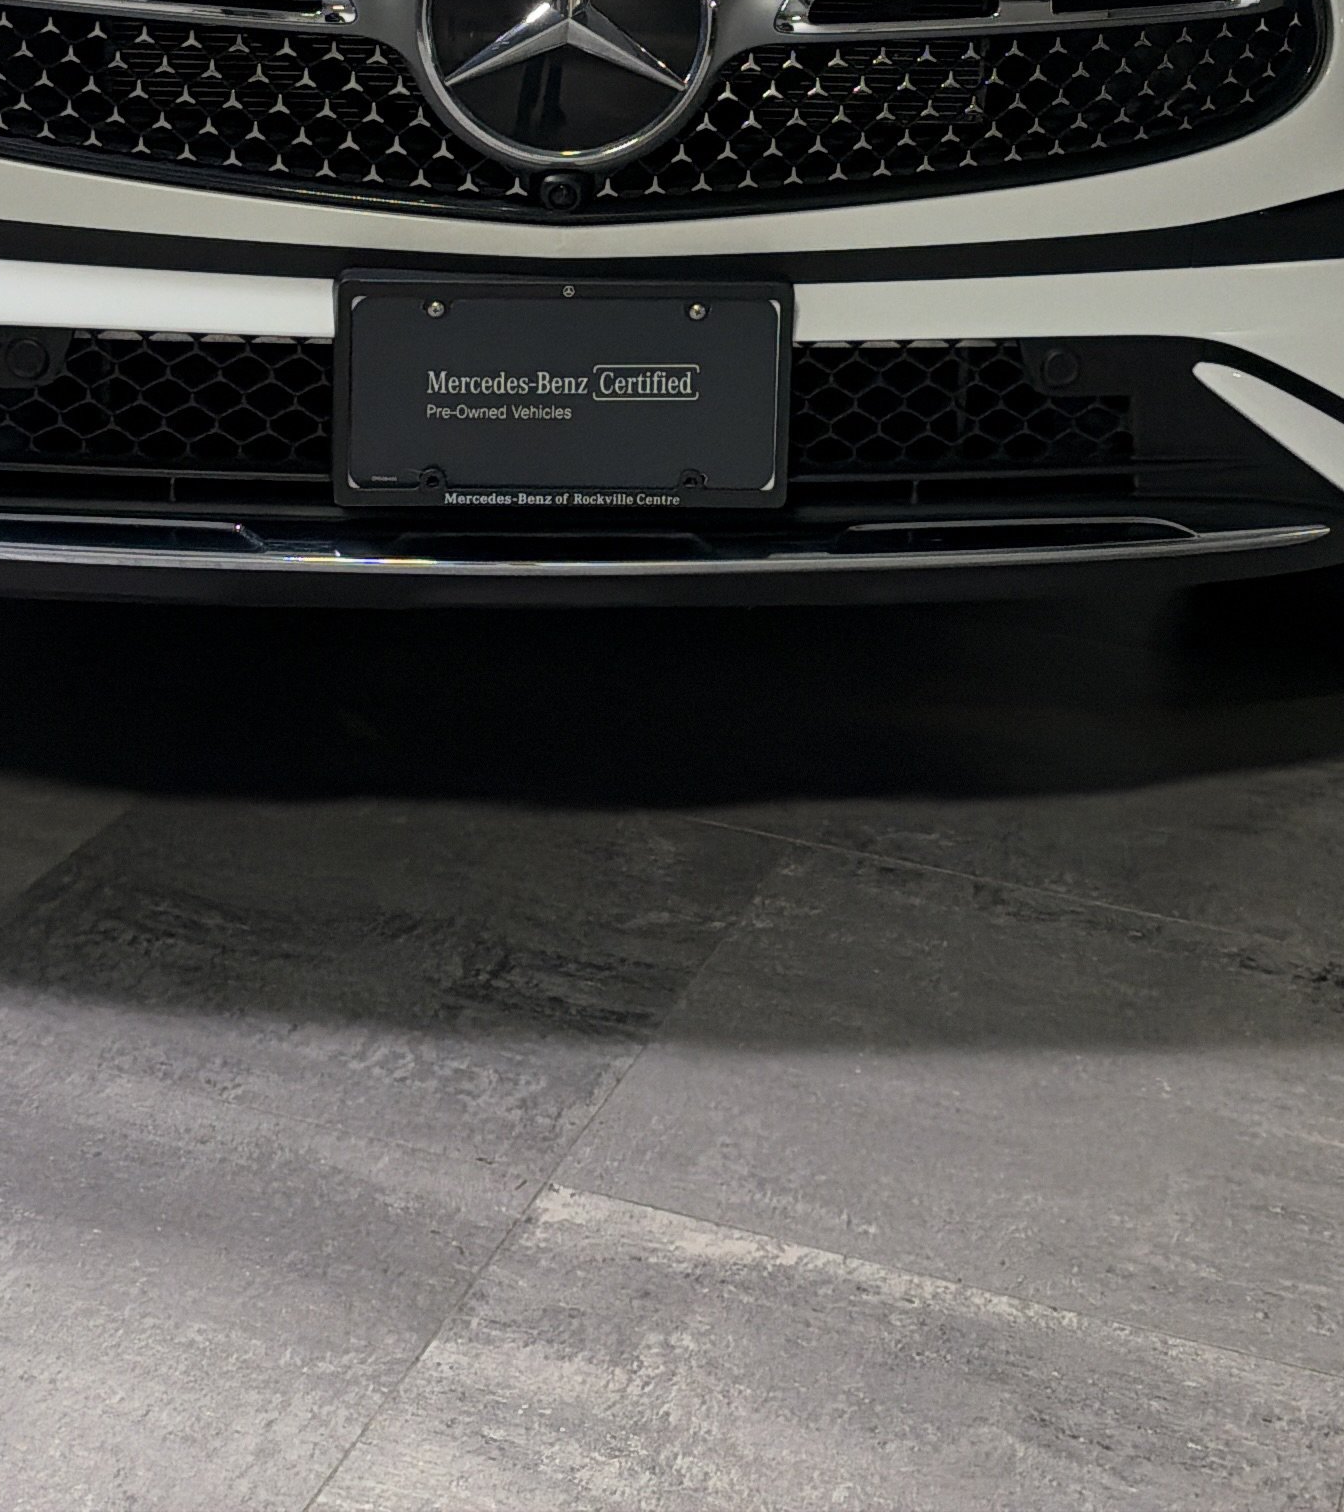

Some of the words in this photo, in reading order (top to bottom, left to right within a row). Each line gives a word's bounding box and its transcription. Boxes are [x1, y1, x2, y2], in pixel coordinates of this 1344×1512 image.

[426, 370, 589, 396] Mercedes-Benz
[599, 371, 693, 396] Certified
[426, 404, 507, 419] Pre-Owned
[511, 404, 573, 419] Vehicles
[444, 492, 553, 506] Mercedes-Benz
[555, 492, 570, 505] of
[573, 492, 634, 506] Rockville
[636, 493, 681, 506] Centre
